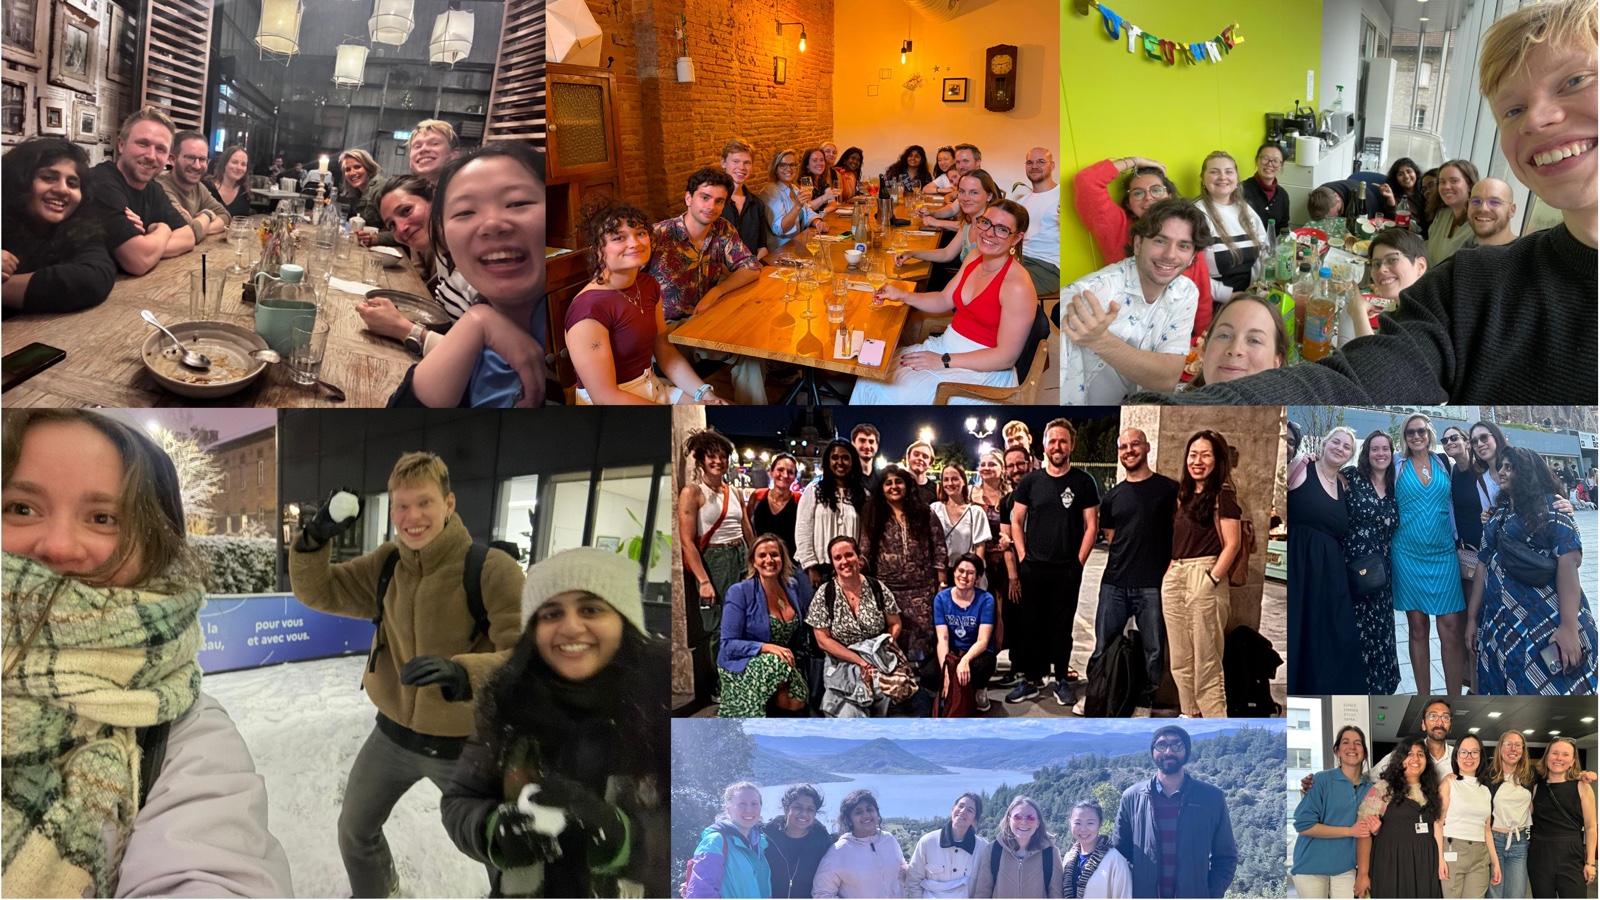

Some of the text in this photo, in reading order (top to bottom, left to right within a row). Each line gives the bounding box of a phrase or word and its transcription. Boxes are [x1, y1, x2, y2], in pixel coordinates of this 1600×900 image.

[207, 622, 218, 634] la
[255, 618, 304, 633] pour vous
[247, 632, 310, 647] et avec vous.
